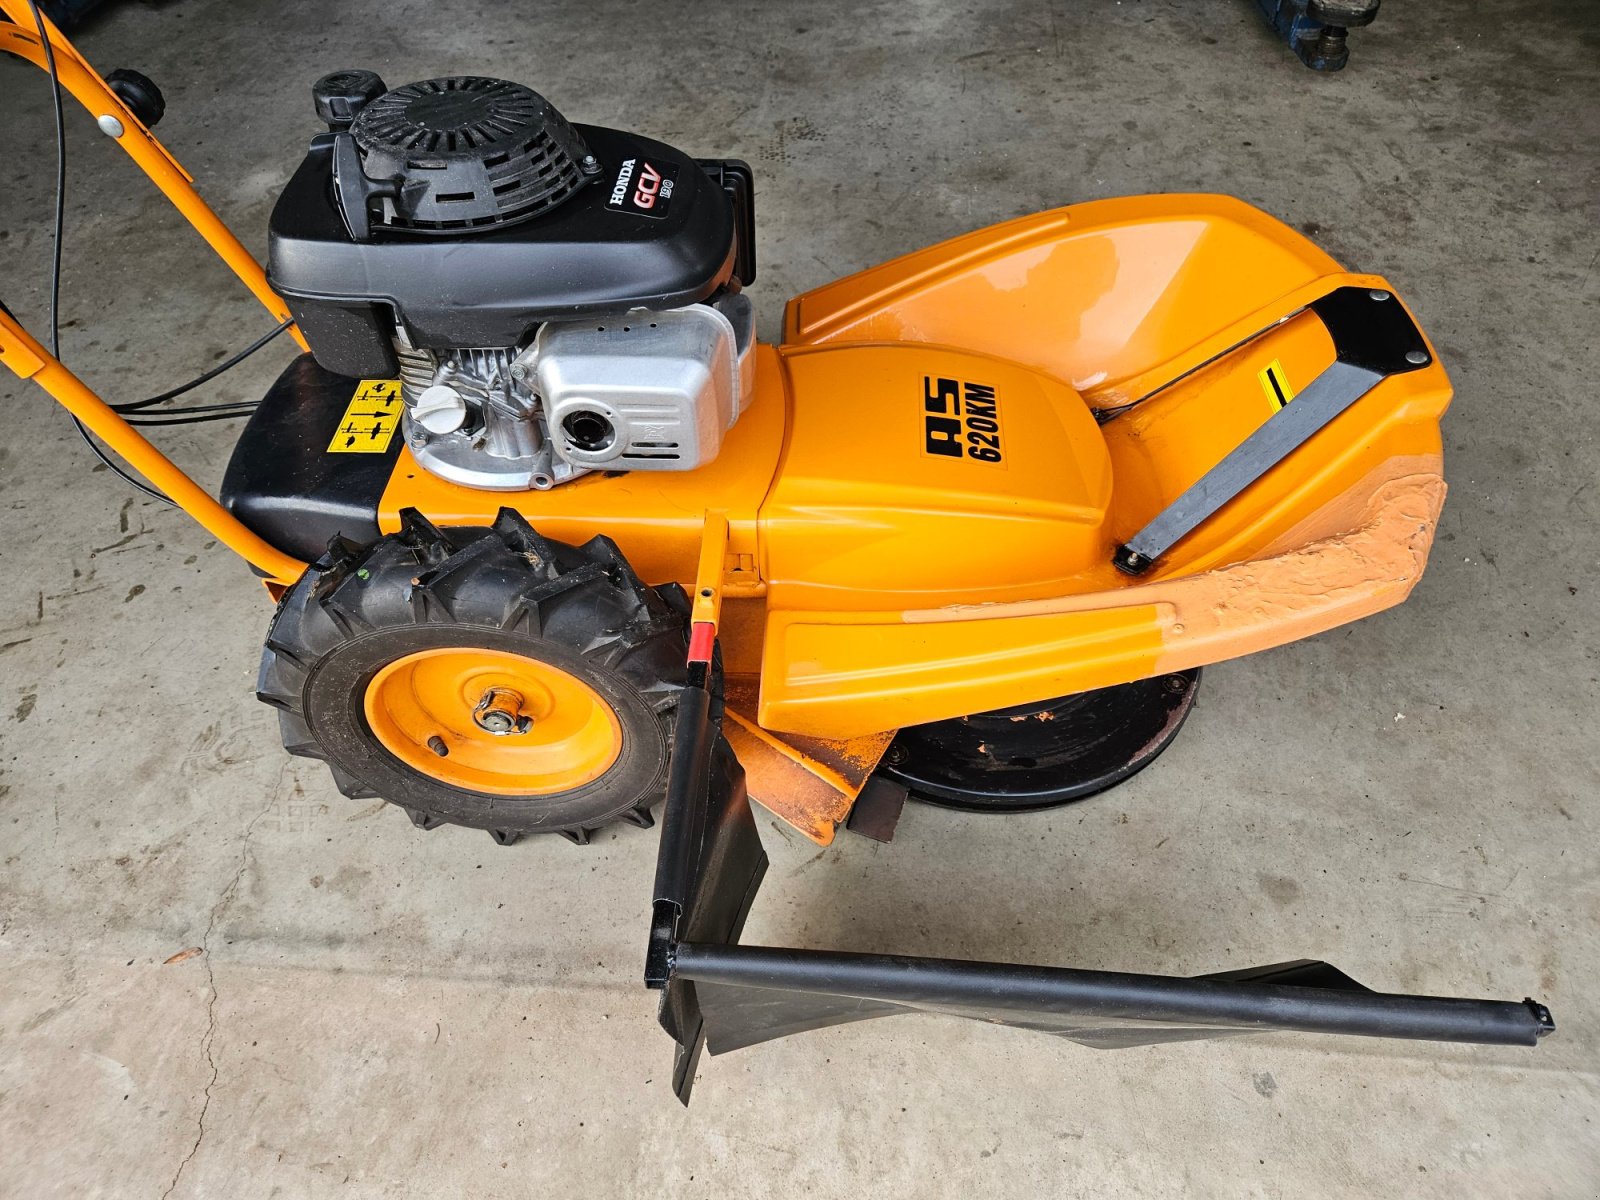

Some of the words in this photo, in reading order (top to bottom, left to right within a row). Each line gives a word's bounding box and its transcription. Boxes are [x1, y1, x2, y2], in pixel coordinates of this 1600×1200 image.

[610, 159, 636, 205] HONDA
[633, 163, 661, 209] GCV
[659, 179, 674, 199] 190
[924, 376, 963, 458] AS
[964, 382, 1002, 463] 620KM
